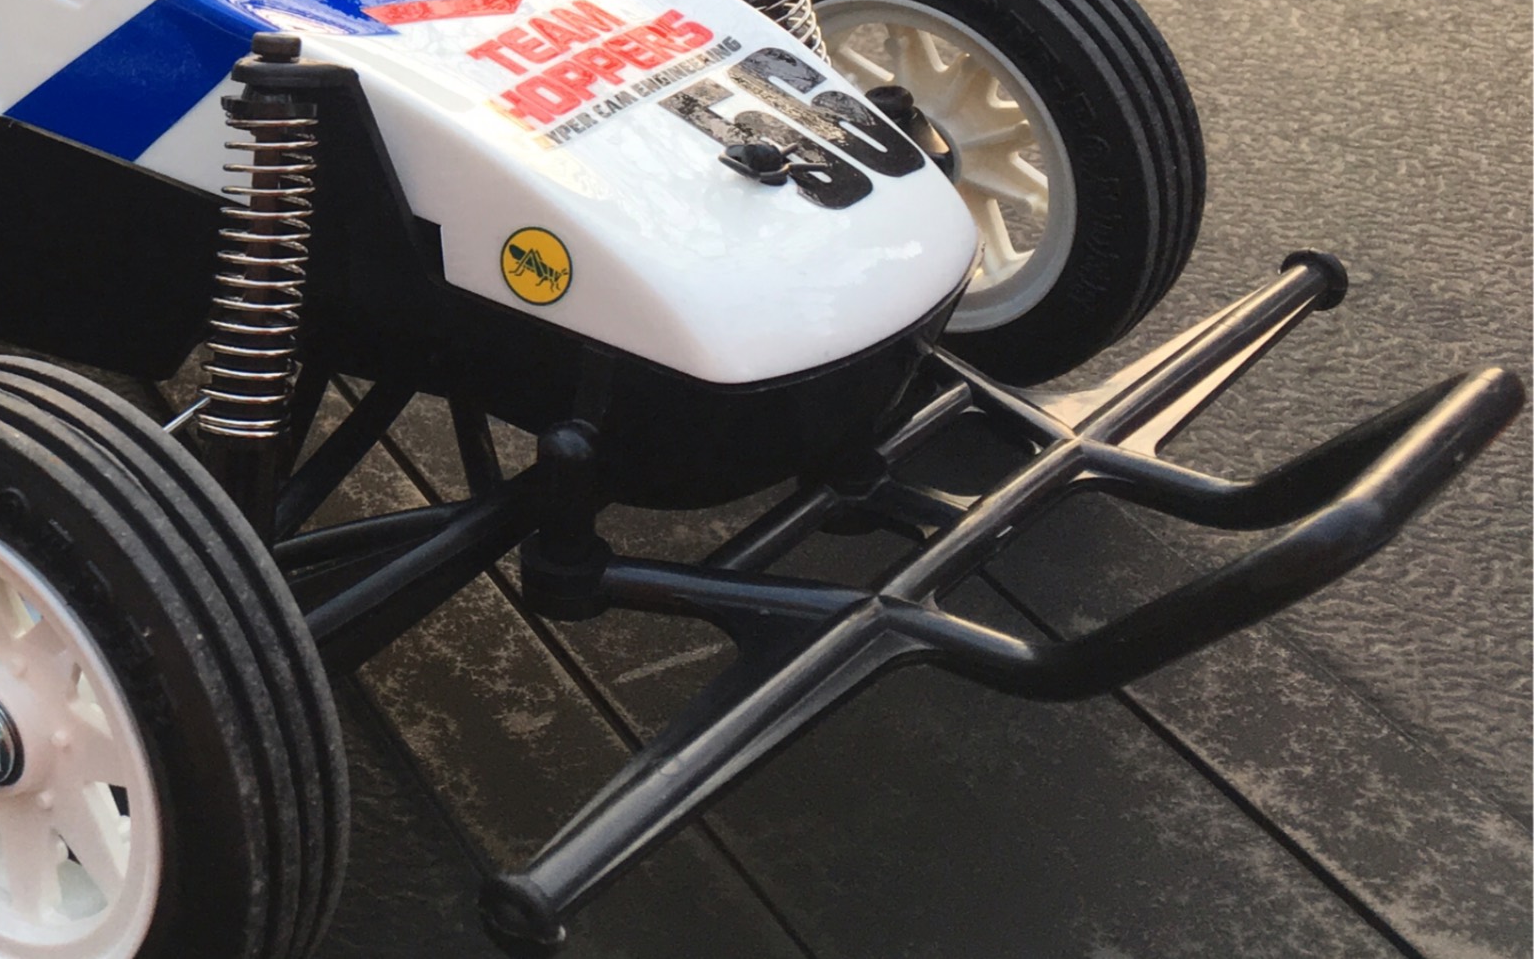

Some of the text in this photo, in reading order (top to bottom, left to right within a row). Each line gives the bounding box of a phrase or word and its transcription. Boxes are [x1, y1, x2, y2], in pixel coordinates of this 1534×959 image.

[485, 8, 715, 131] HOPPERS
[533, 111, 600, 151] YPER
[630, 35, 743, 98] ENGINEERING
[658, 47, 927, 211] 56
